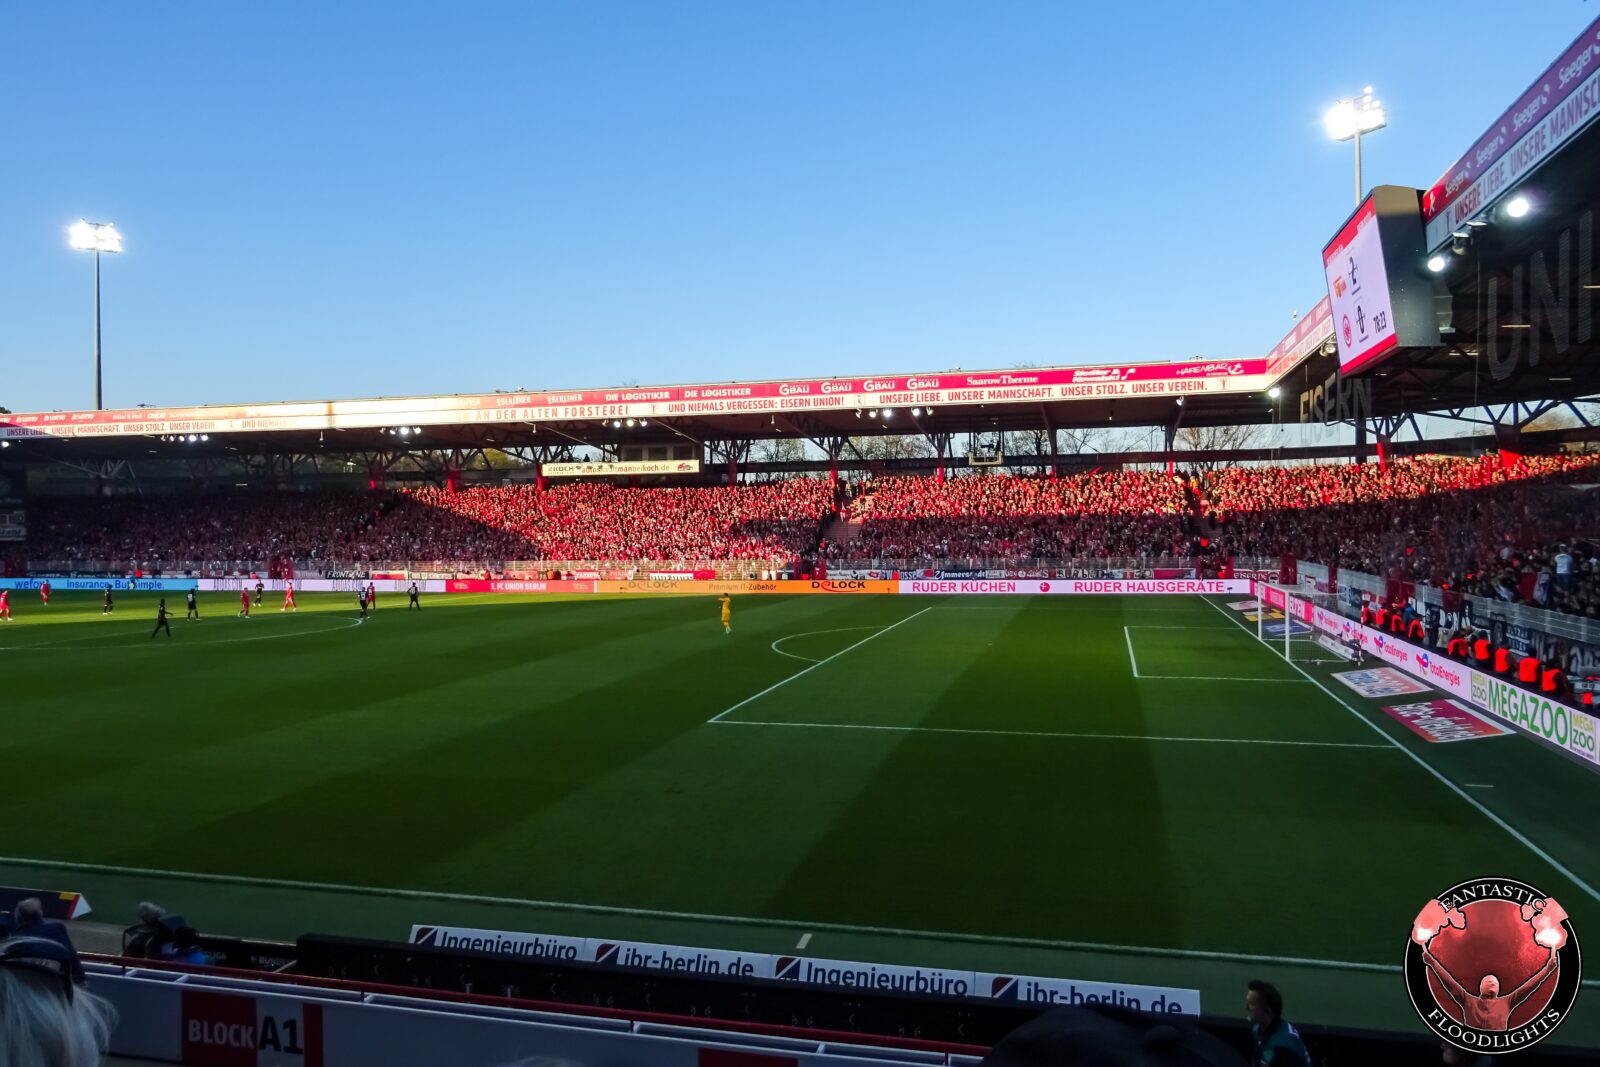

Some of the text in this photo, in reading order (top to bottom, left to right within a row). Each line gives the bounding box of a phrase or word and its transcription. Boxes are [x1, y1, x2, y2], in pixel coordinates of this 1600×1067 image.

[1558, 44, 1594, 89] Seeger
[1512, 96, 1541, 132] Seeger
[1476, 137, 1500, 168] Seeger
[1454, 181, 1481, 225] UNSERE
[1510, 126, 1546, 176] UNSERE
[1177, 363, 1228, 376] HAFENBAR
[622, 392, 670, 400] LOGISTIKER
[684, 388, 751, 398] DIE LOGISTIKER
[880, 380, 1208, 404] UNSERE LIEBE. UNSERE MANNSCHAFT. UNSER STOLZ. UNSER VEREIN.
[496, 408, 516, 419] DER
[523, 406, 558, 418] ALTEN
[668, 396, 844, 413] UND NIEMALS VERGESSEN: EISERN UNION!
[7, 428, 29, 436] UNSERE
[52, 426, 74, 435] UNSERE
[77, 424, 121, 434] MANNSCHAFT.
[123, 423, 144, 433] UNSER
[145, 422, 166, 432] STOLZ.
[169, 422, 190, 431] UNSER
[912, 579, 1016, 592] RUDER KÜCHEN
[1074, 580, 1224, 592] RUDER HAUSGERÄTE
[1429, 661, 1460, 686] TotalEnergies
[1472, 684, 1487, 702] ZOO
[1488, 680, 1568, 745] MEGAZOO
[1572, 729, 1595, 752] ZOO
[440, 931, 754, 977] Ingenieurbüro ibr-berlin.de
[806, 962, 1182, 1013] Ingenieurbüro ibr-berlinde
[188, 1015, 304, 1055] BLOCK A1
